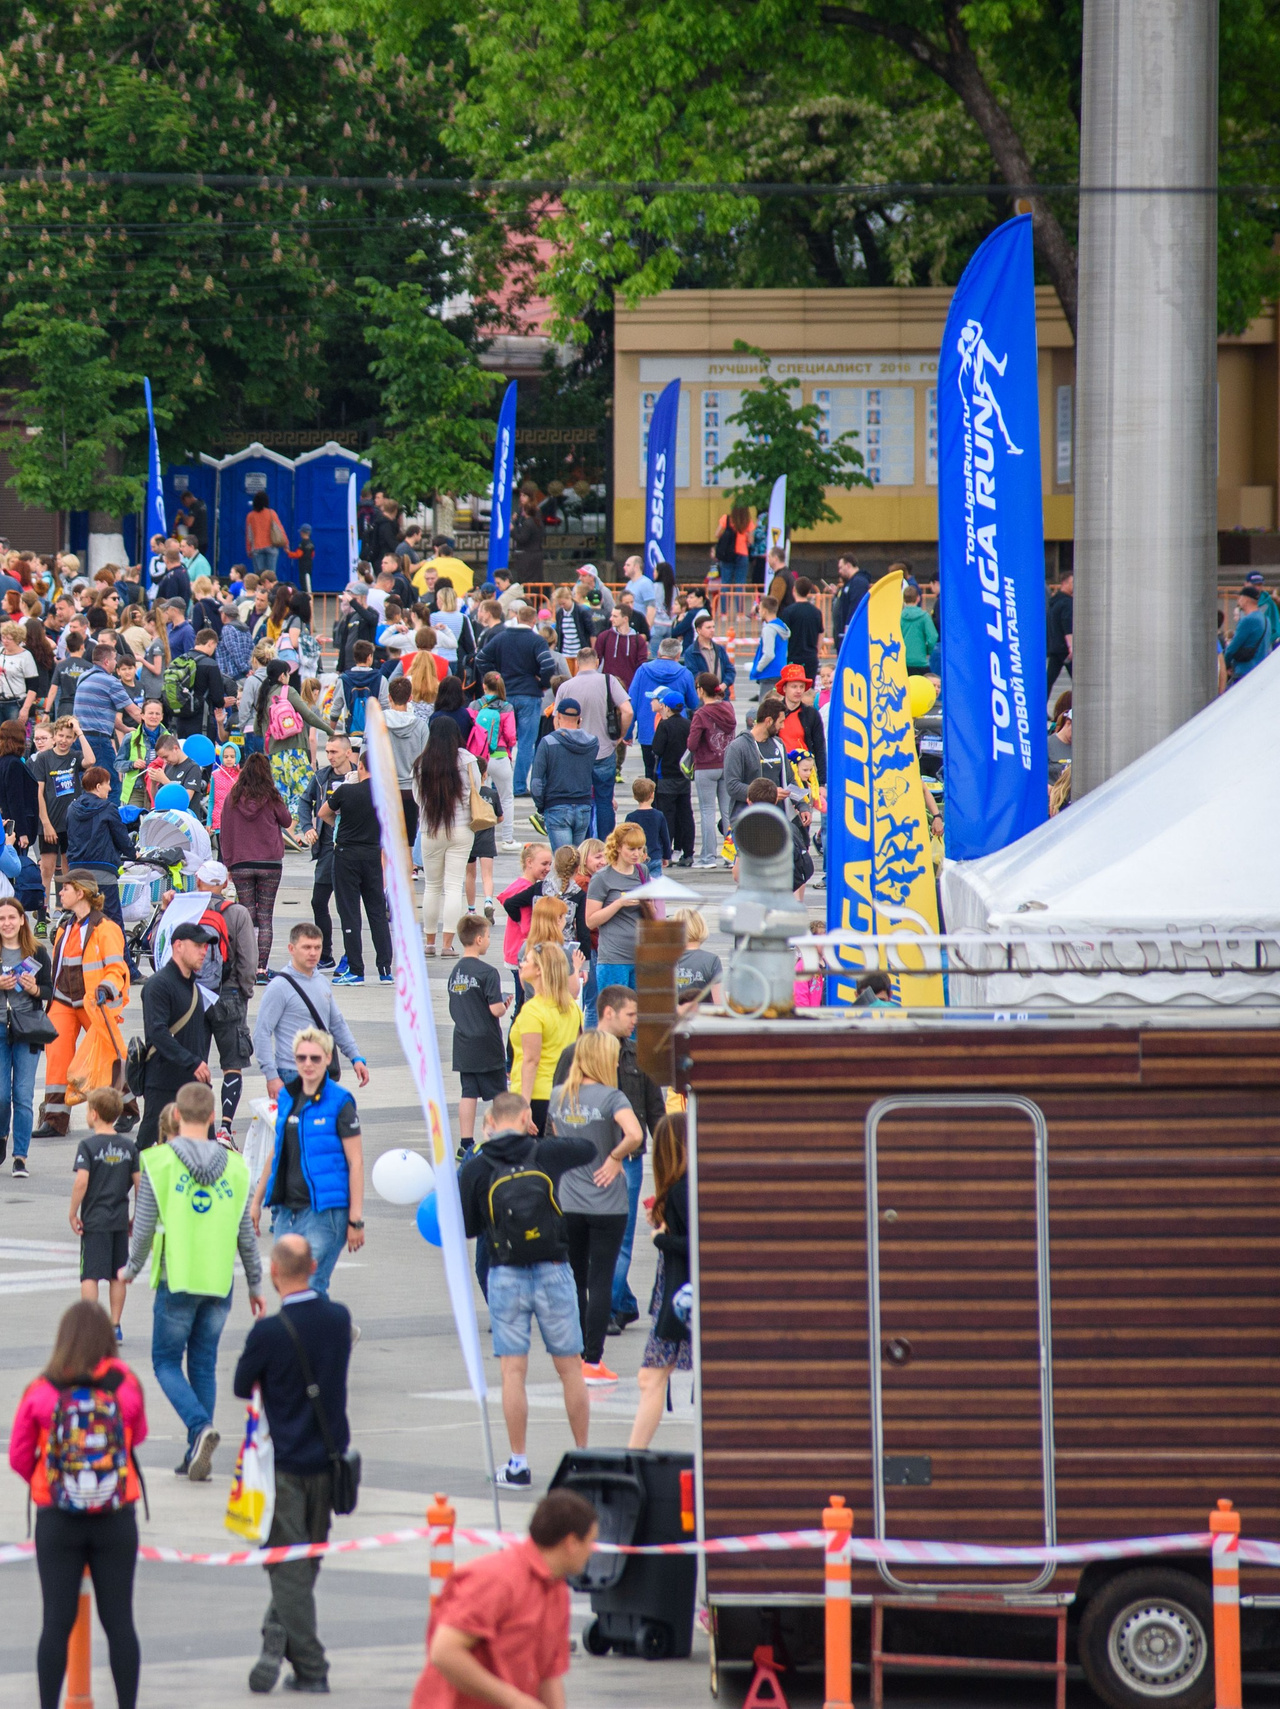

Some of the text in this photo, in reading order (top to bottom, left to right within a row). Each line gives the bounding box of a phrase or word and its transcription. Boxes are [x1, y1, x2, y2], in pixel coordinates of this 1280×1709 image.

[777, 362, 873, 374] СПЕЦИАЛИСТ
[879, 362, 911, 373] 2016
[651, 453, 667, 540] asics
[973, 394, 1016, 762] TOP LIGA RUN
[842, 666, 872, 843] CLUB
[1003, 577, 1031, 771] БЕГОВОЙ МАГАЗИН
